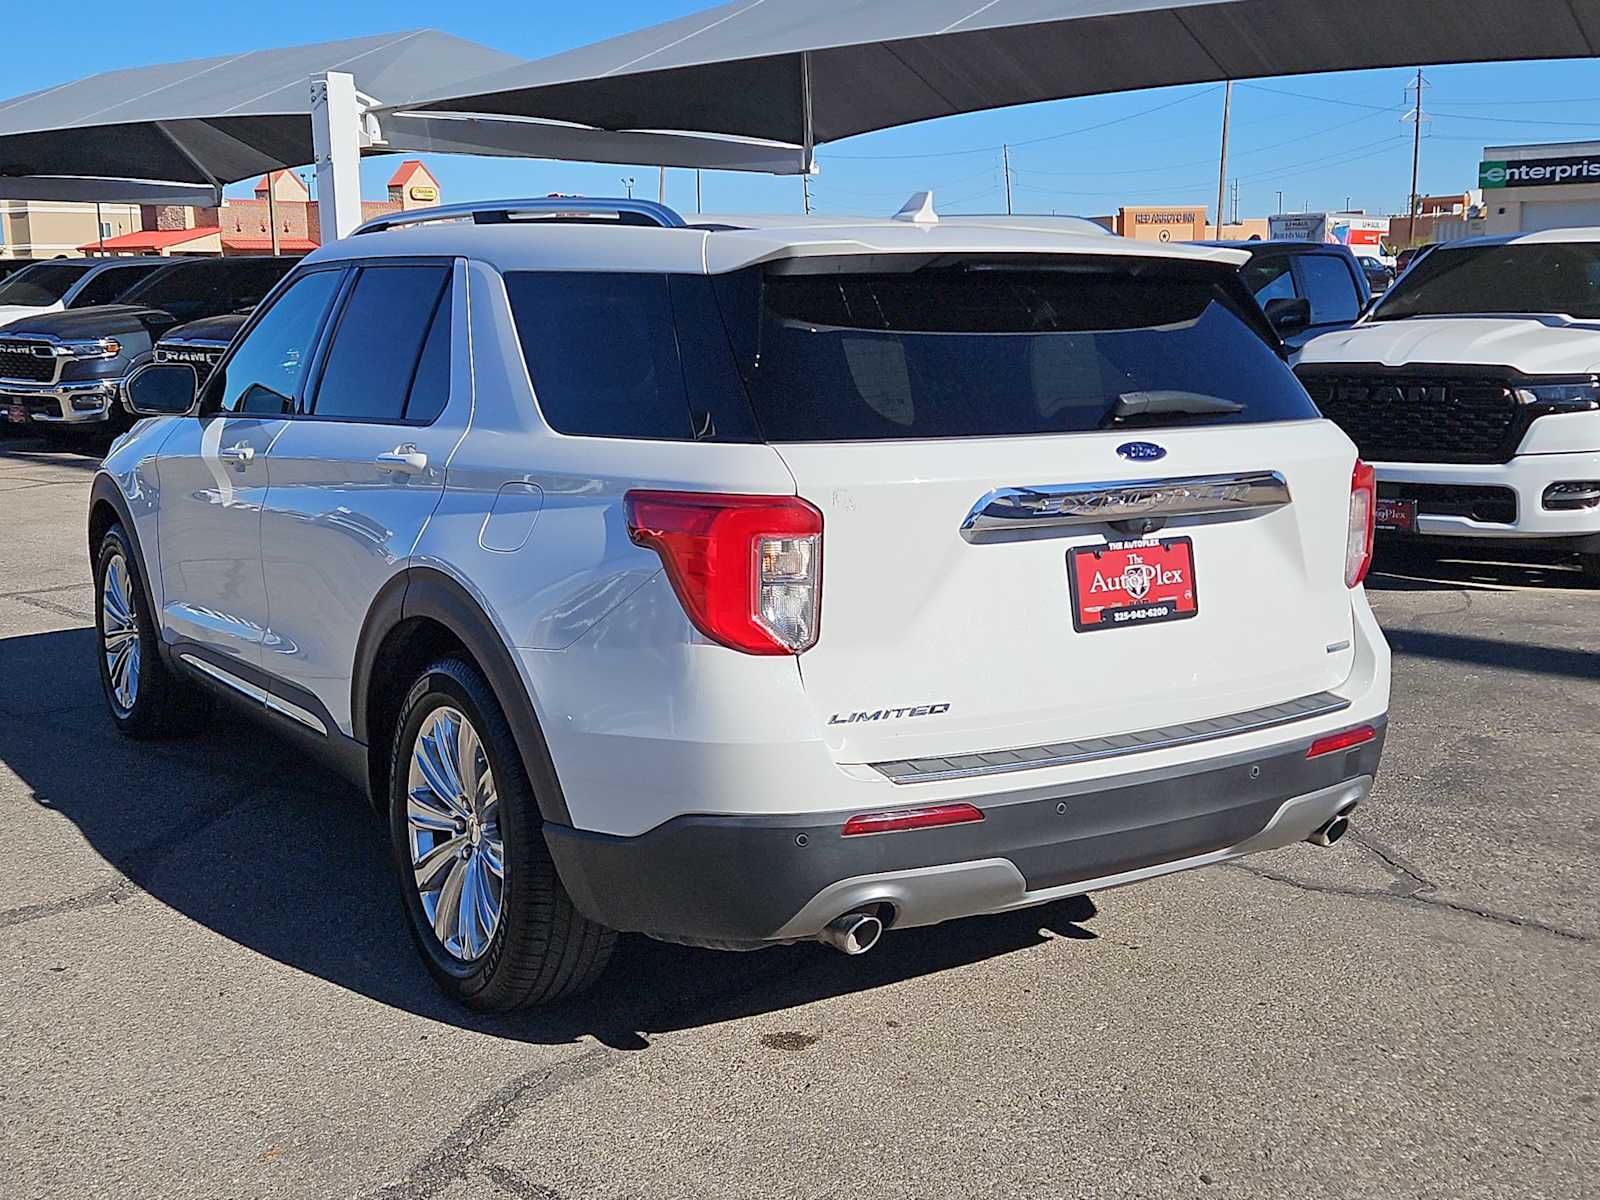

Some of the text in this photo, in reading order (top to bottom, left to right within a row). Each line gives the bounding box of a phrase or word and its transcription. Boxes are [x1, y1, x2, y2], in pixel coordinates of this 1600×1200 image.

[167, 351, 205, 362] RAM
[1130, 445, 1158, 457] Ford
[1109, 539, 1160, 551] THE AUTOPLEX
[1127, 553, 1143, 565] The
[1089, 563, 1183, 593] AutoPlex
[1114, 606, 1169, 621] 325-942-6200
[828, 703, 950, 724] LIMITED
